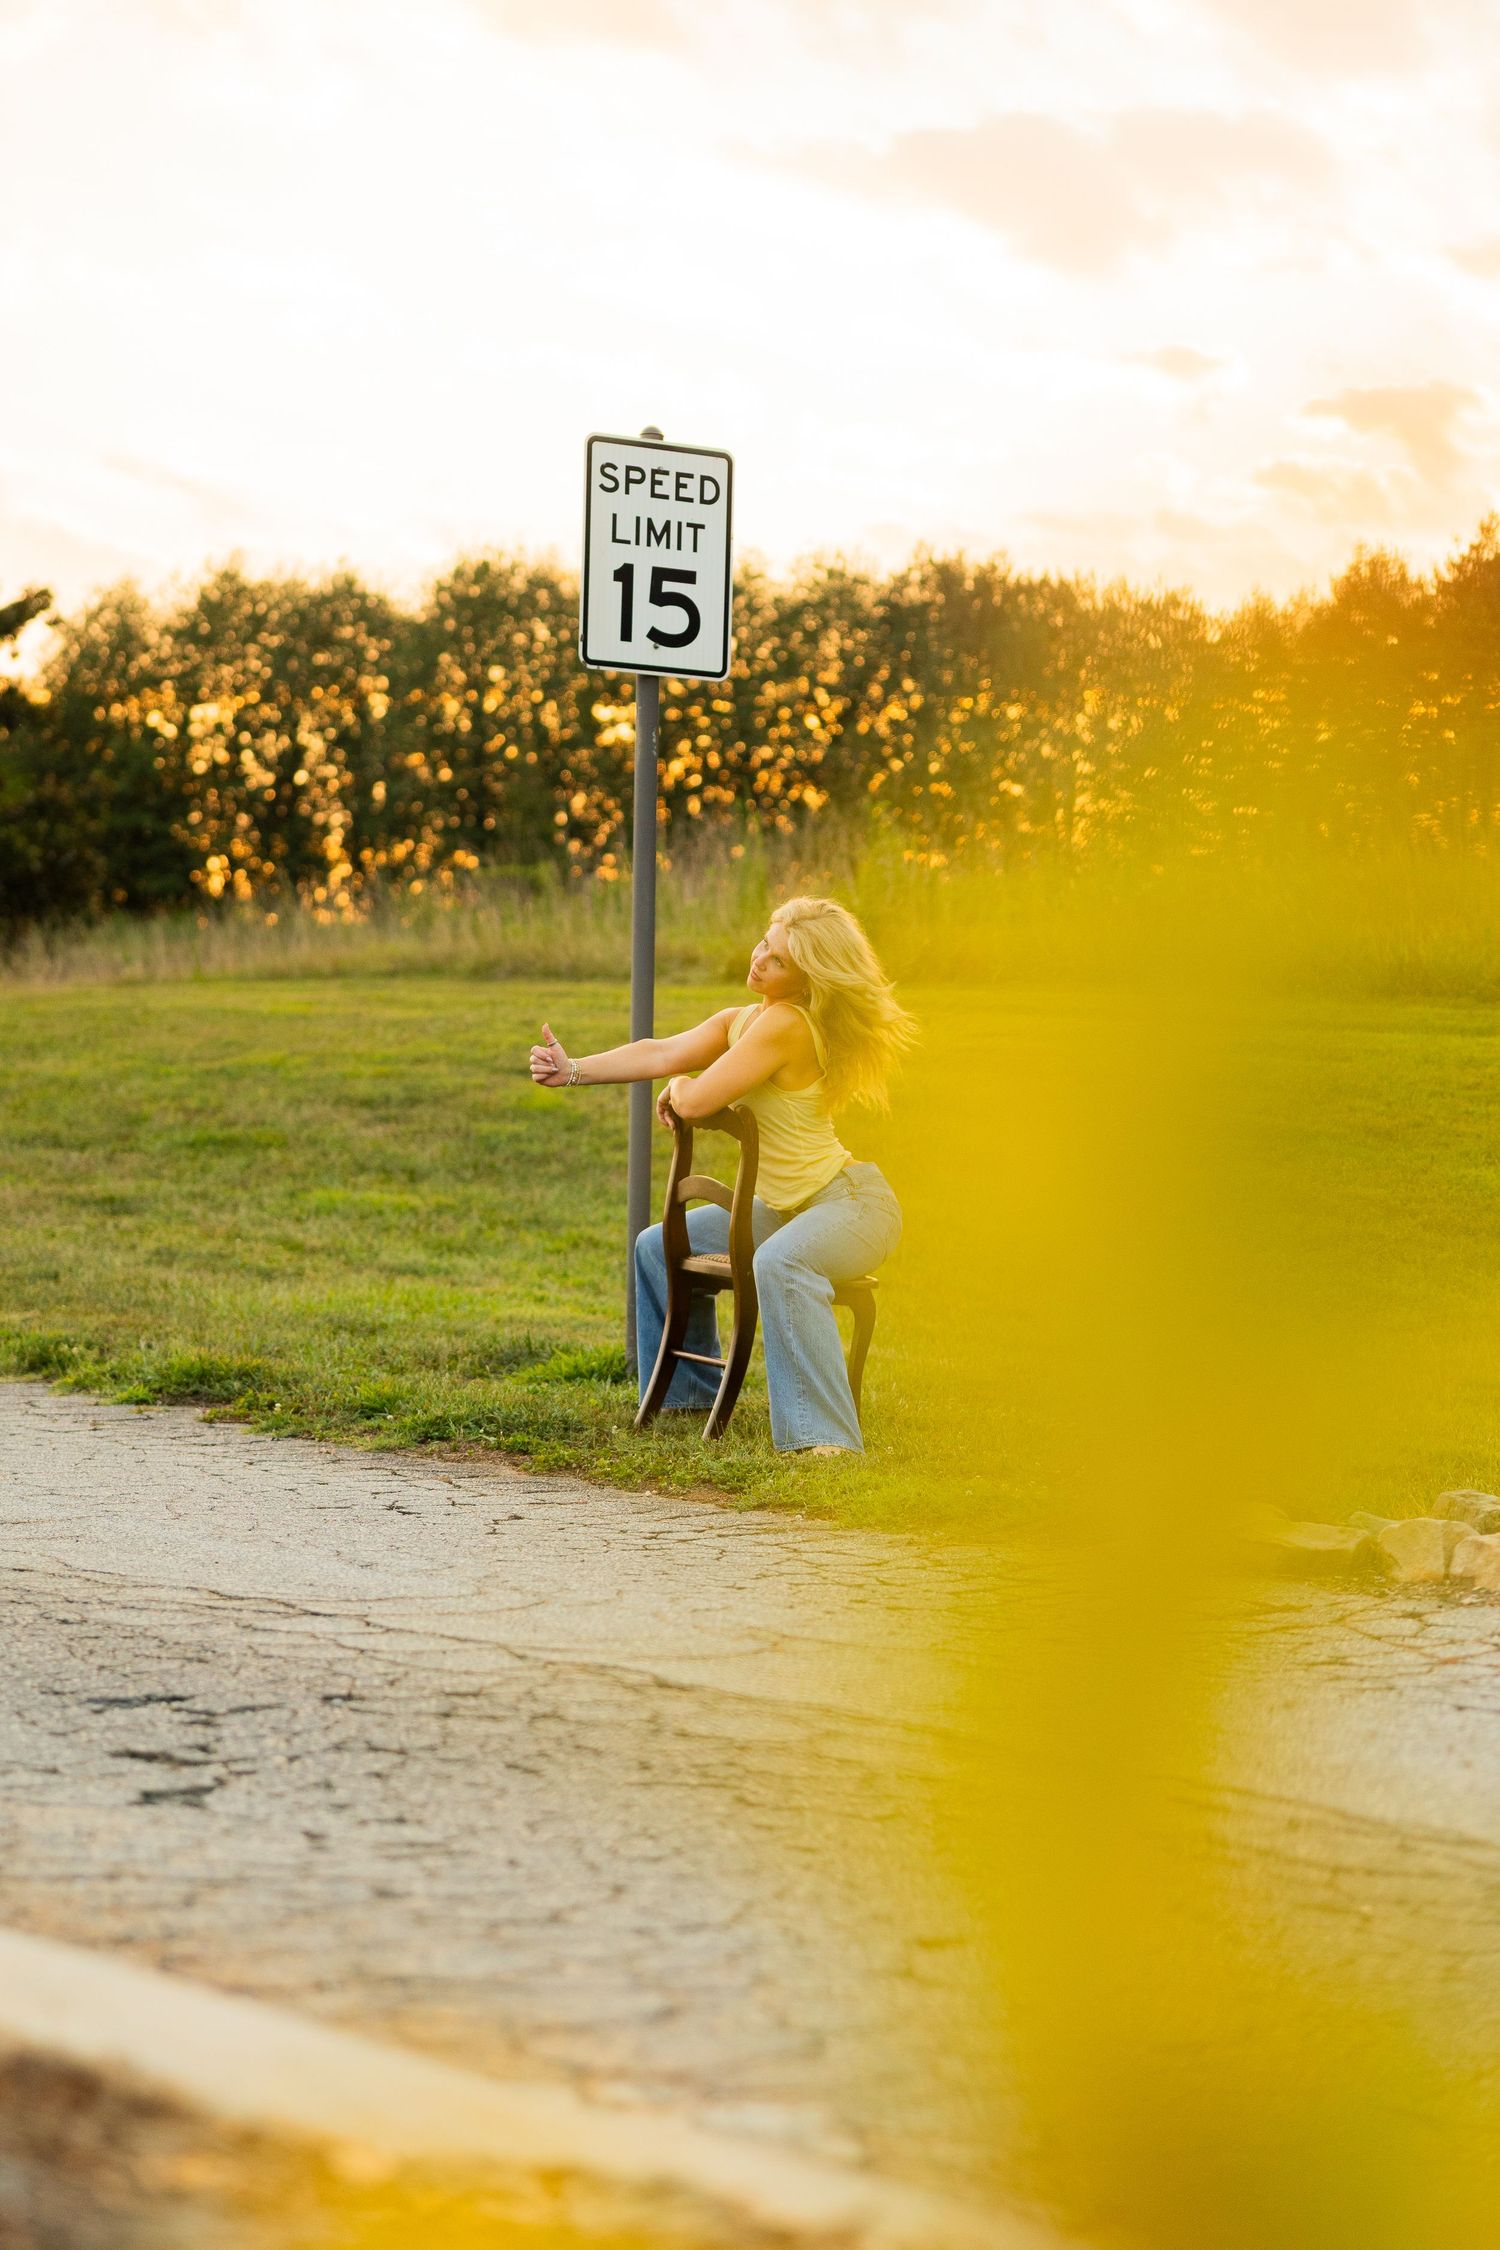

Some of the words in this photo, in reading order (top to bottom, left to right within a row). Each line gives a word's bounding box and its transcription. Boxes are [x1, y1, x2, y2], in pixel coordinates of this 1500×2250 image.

[598, 462, 721, 506] SPEED
[611, 512, 706, 553] LIMIT
[612, 562, 701, 649] 15
